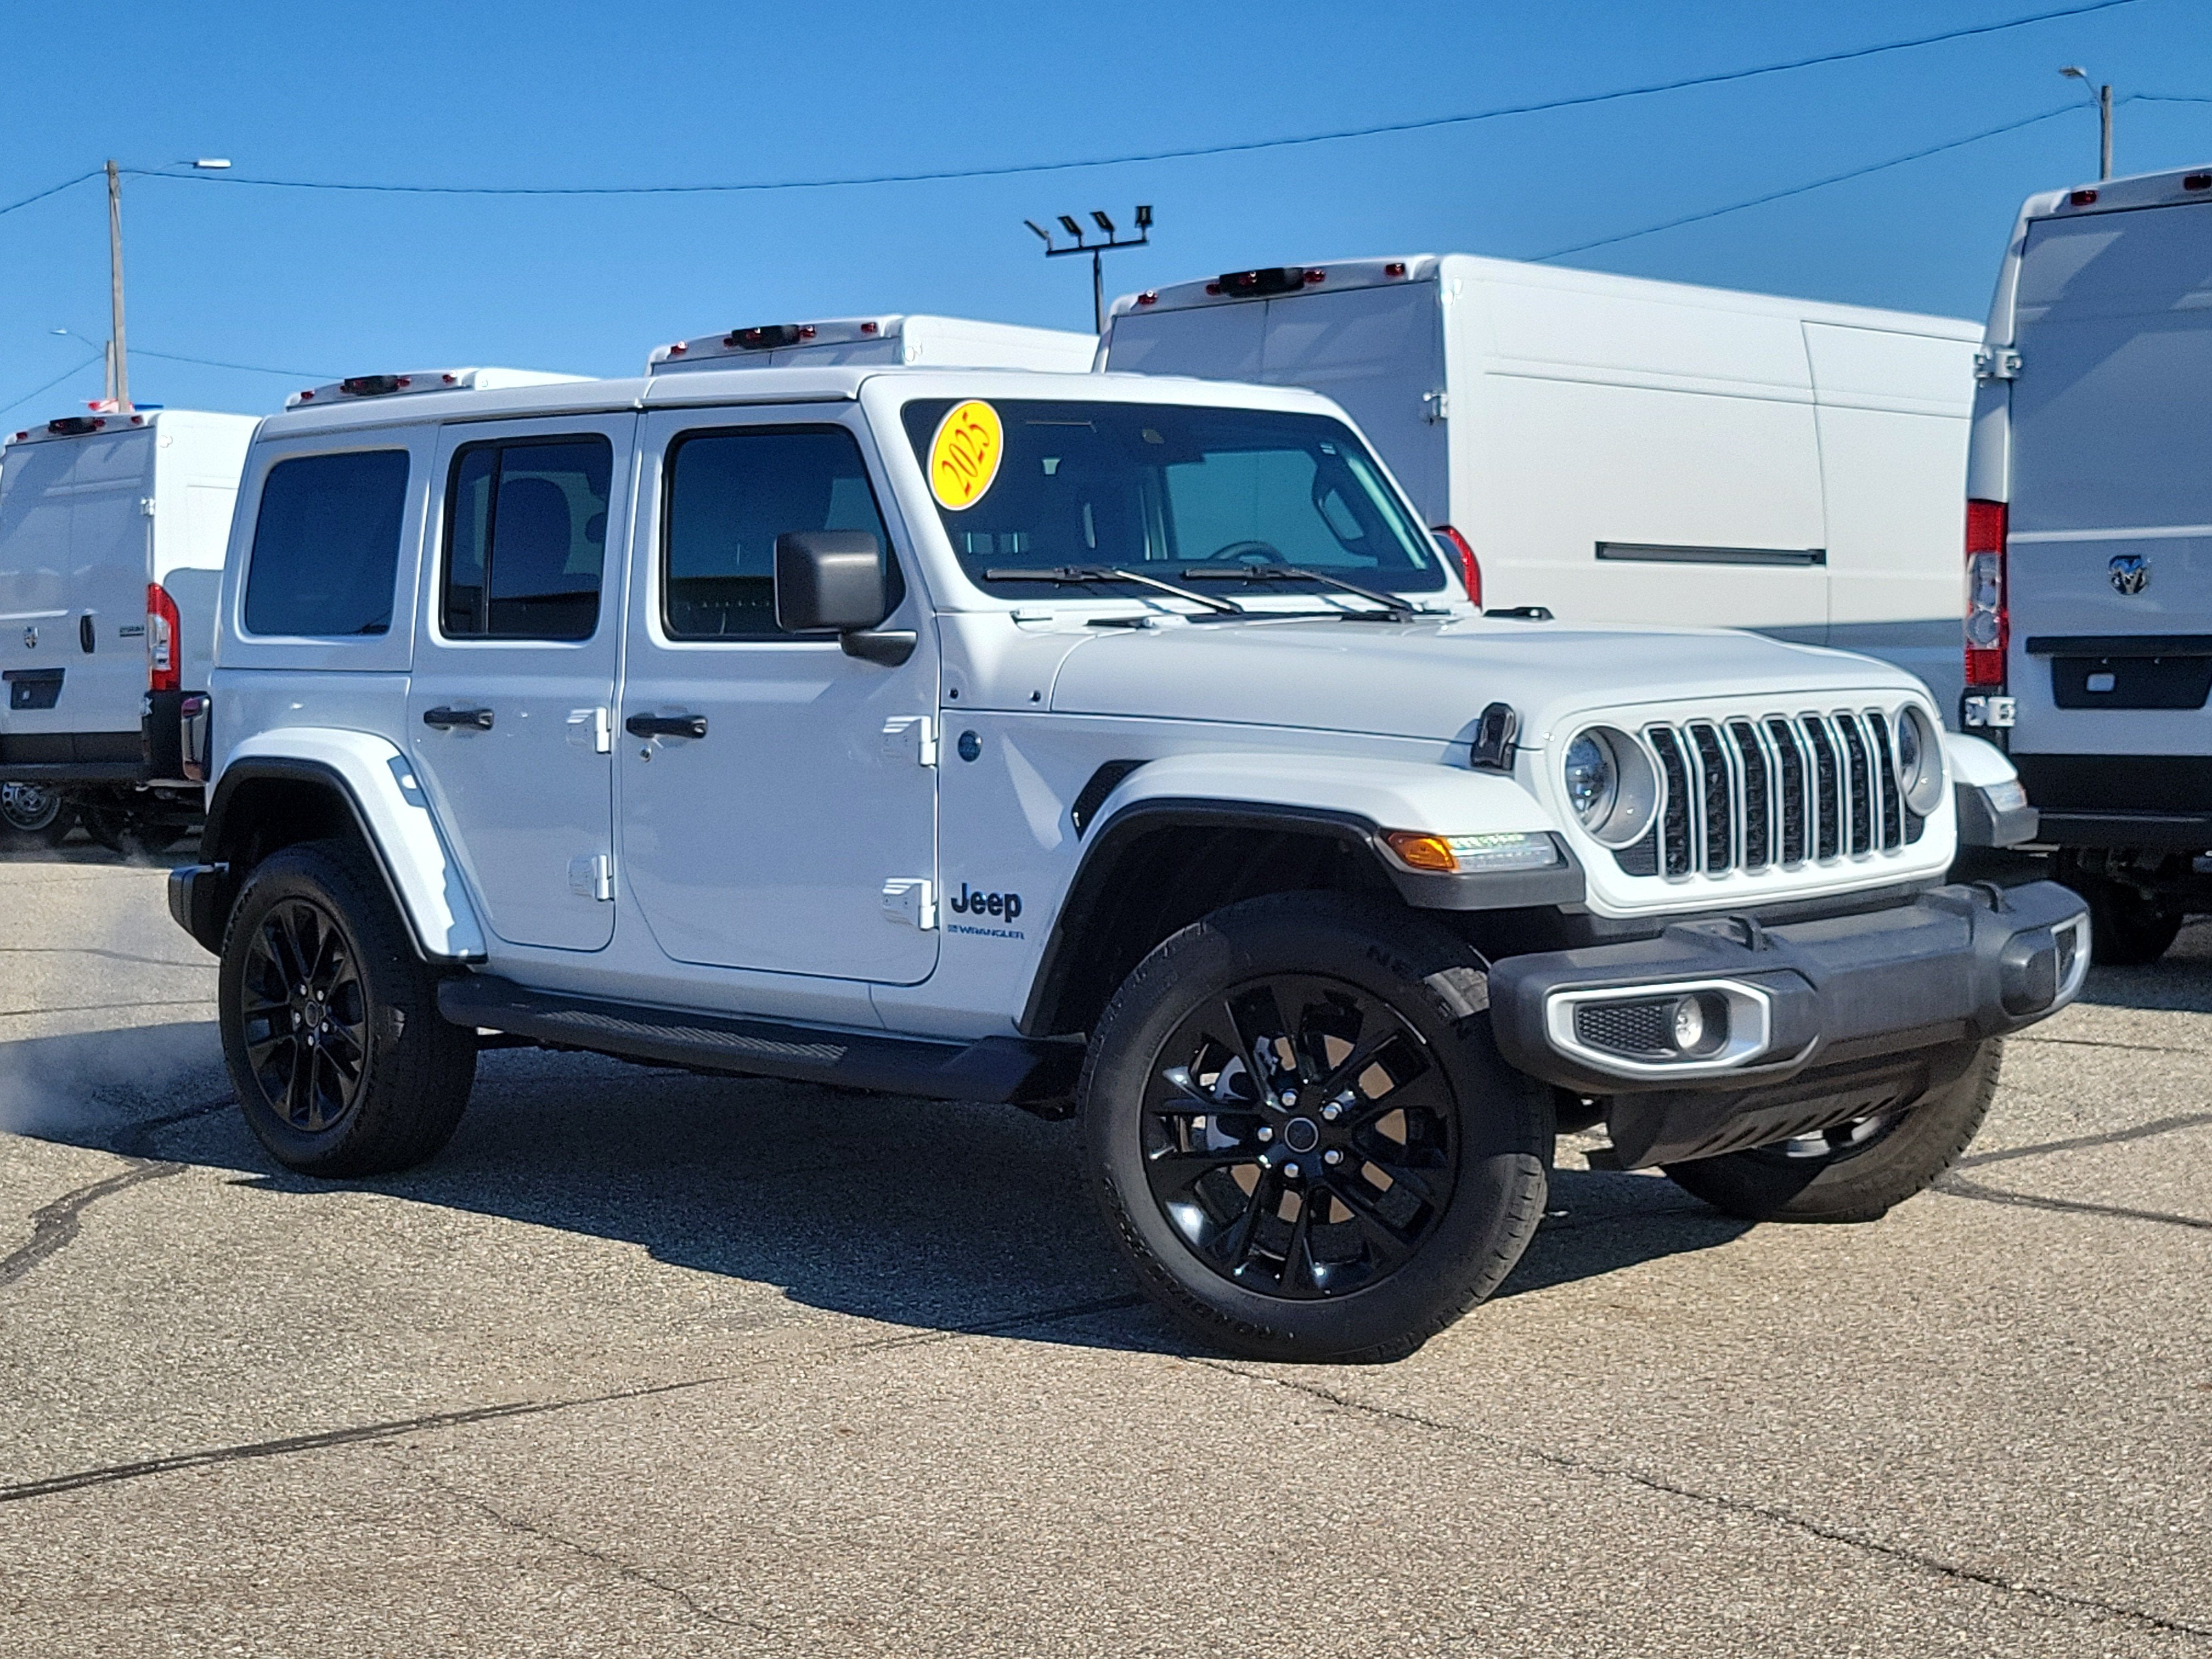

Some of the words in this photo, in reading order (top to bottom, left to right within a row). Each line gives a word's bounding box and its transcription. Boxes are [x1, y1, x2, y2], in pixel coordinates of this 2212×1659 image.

[941, 410, 990, 497] 2025
[951, 882, 1022, 923] Jeep
[958, 925, 1025, 939] WRANGLER
